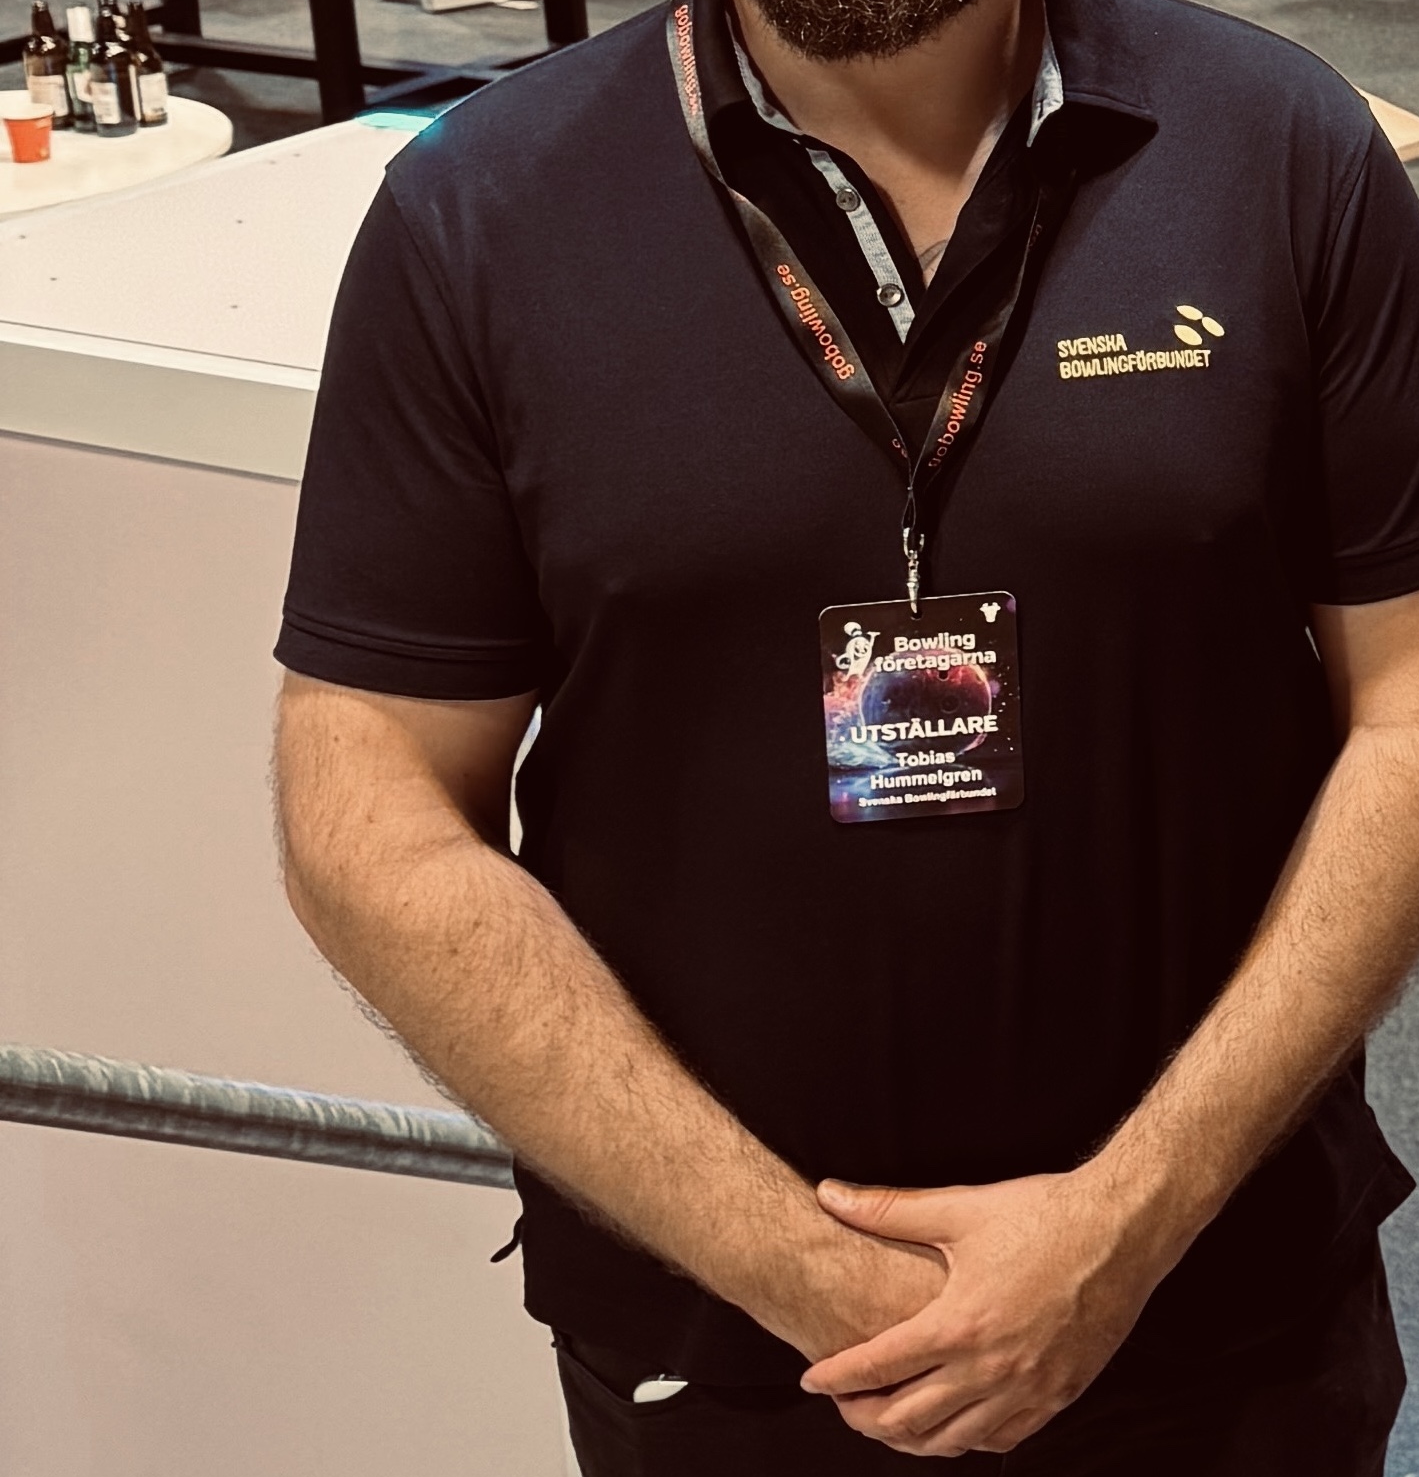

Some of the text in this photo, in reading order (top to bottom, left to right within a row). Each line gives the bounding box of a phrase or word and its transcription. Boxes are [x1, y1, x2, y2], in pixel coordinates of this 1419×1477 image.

[776, 263, 855, 380] gobowling.se
[1057, 333, 1128, 359] SVENSKA
[1059, 349, 1212, 380] BOWLINGFÖRBUNDET
[928, 339, 989, 468] gobowling.se
[894, 632, 976, 653] Bowling
[873, 650, 998, 673] företagarna
[850, 714, 999, 744] UTSTÄLLARE
[896, 750, 956, 768] Tobias
[870, 768, 983, 790] Hummelgren
